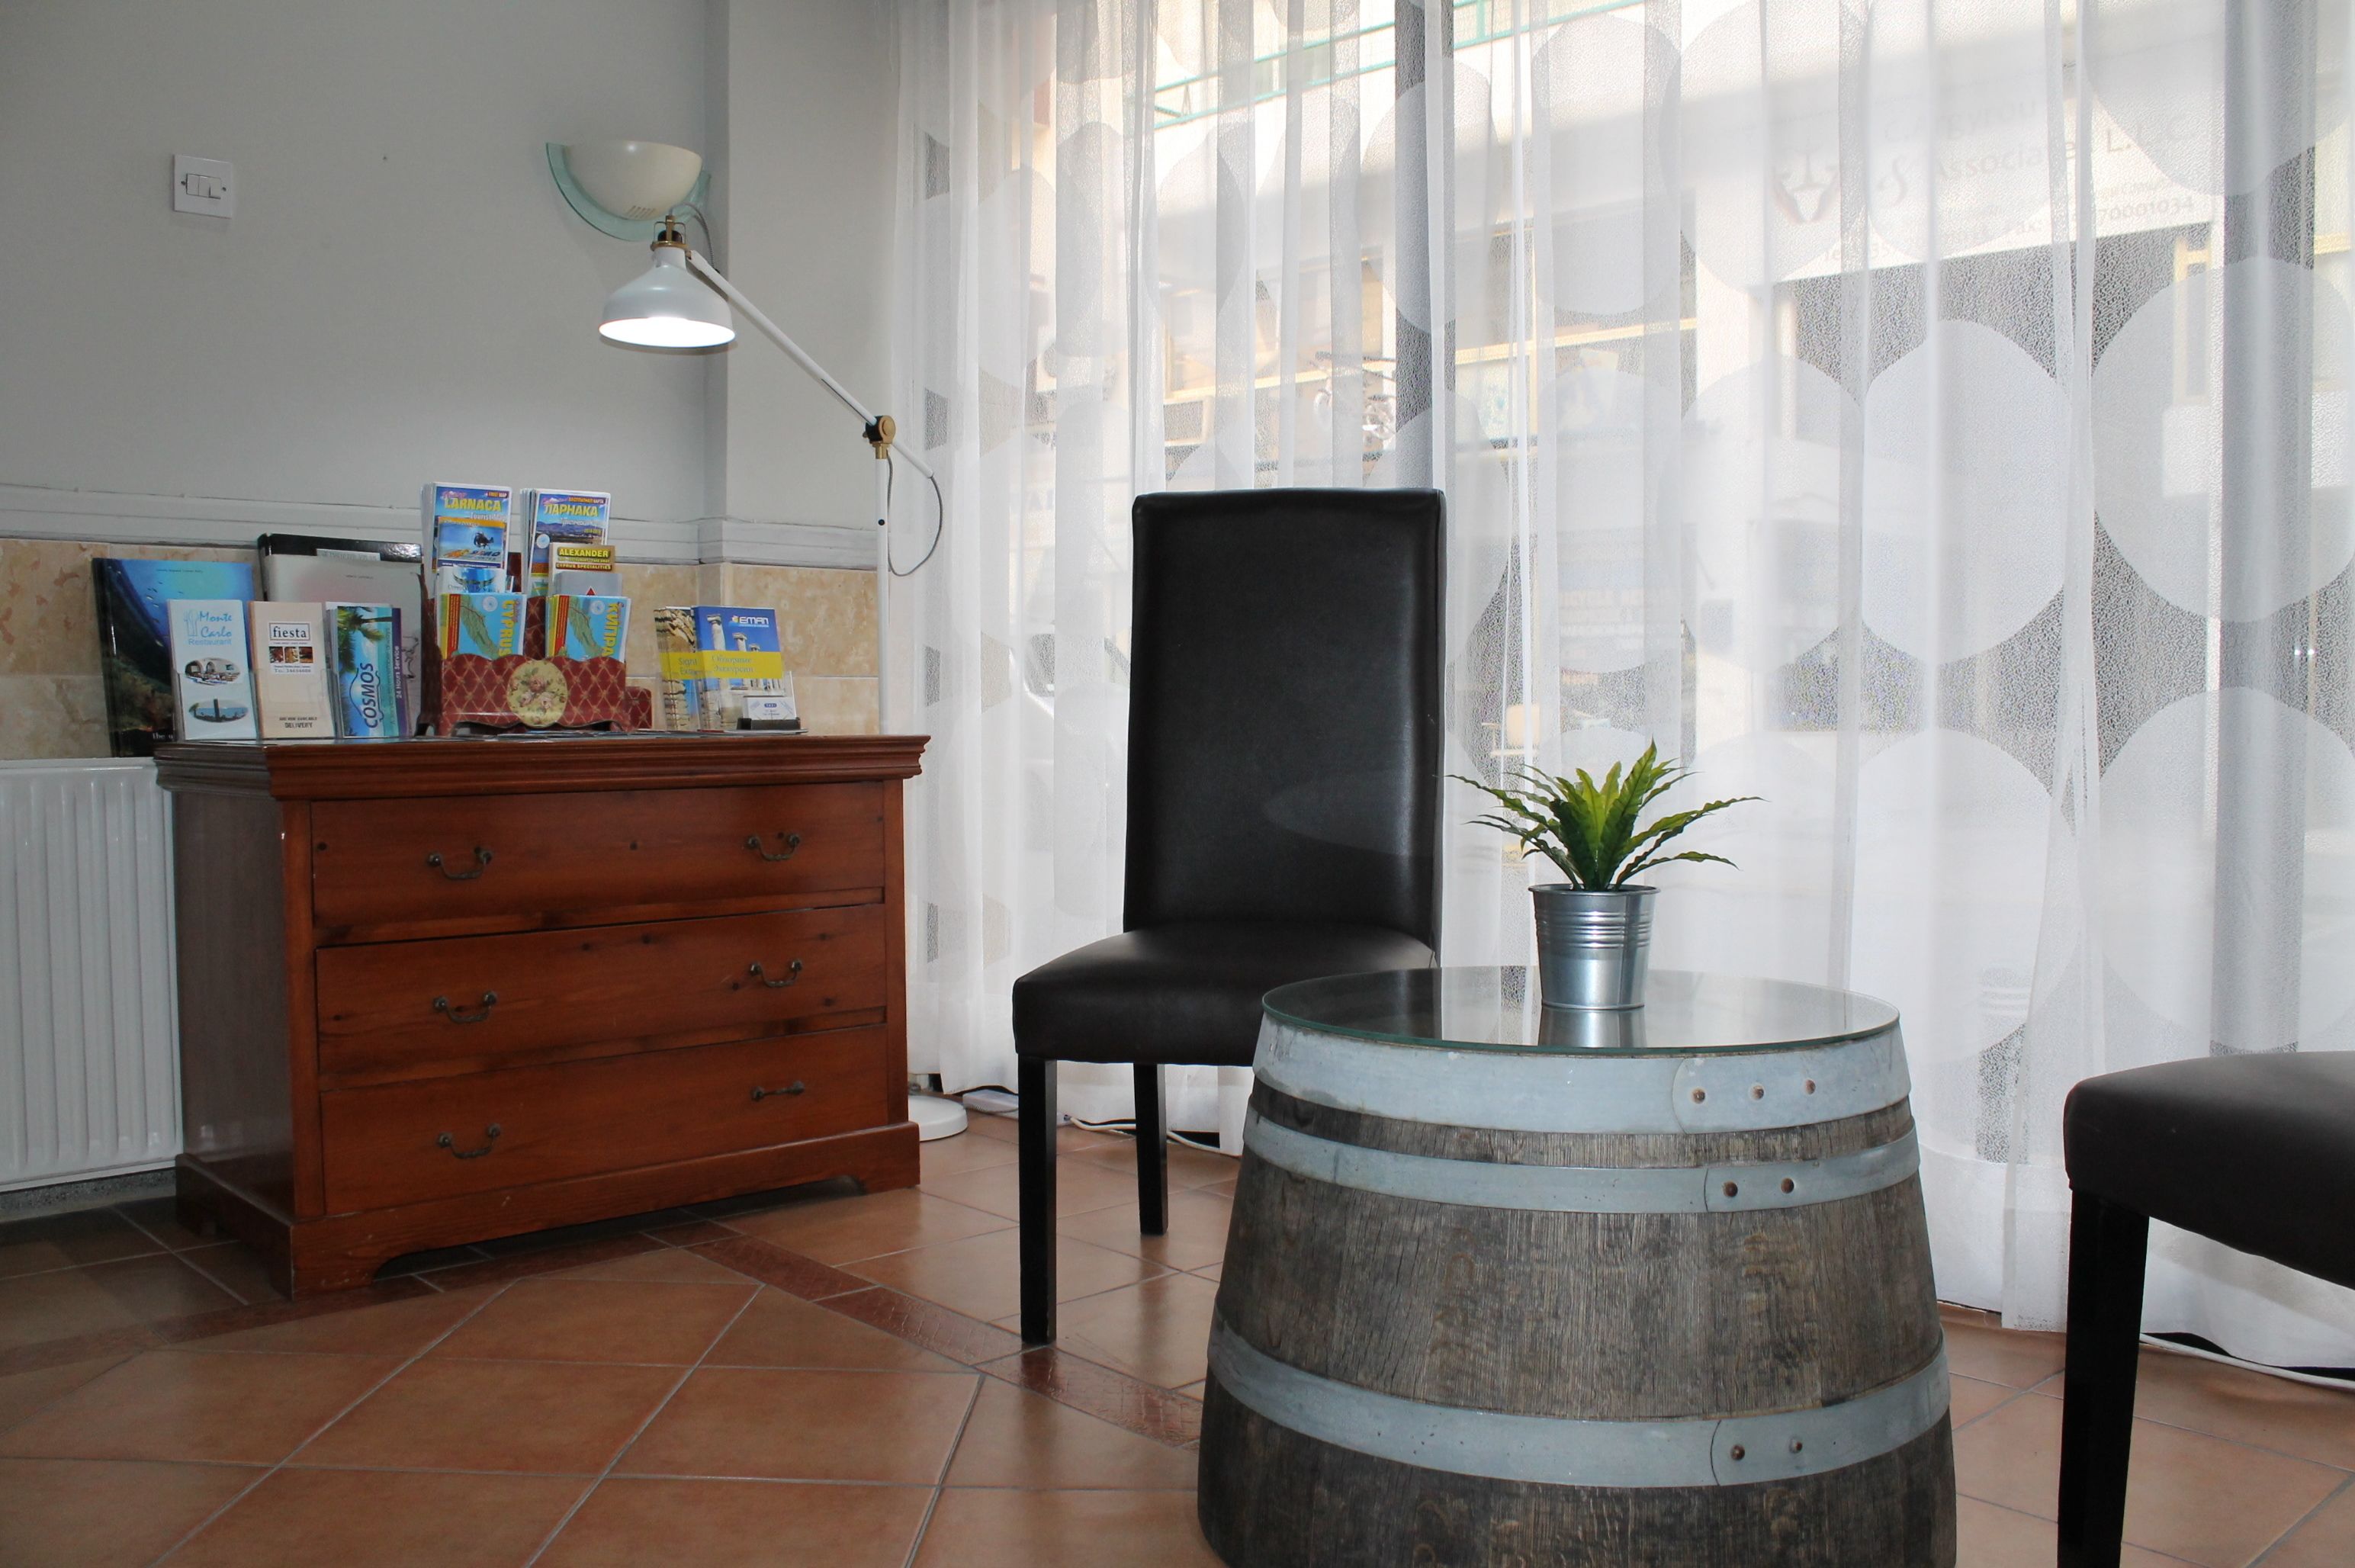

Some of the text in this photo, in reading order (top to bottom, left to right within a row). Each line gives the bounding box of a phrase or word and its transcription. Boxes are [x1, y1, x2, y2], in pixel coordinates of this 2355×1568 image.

[445, 497, 501, 512] LARNACA
[559, 548, 609, 557] ALEXANDER
[199, 611, 233, 622] Monte
[201, 626, 233, 638] Carlo
[273, 625, 307, 638] fiesta
[499, 599, 516, 657] CYPRUS
[359, 662, 378, 729] COSMOS
